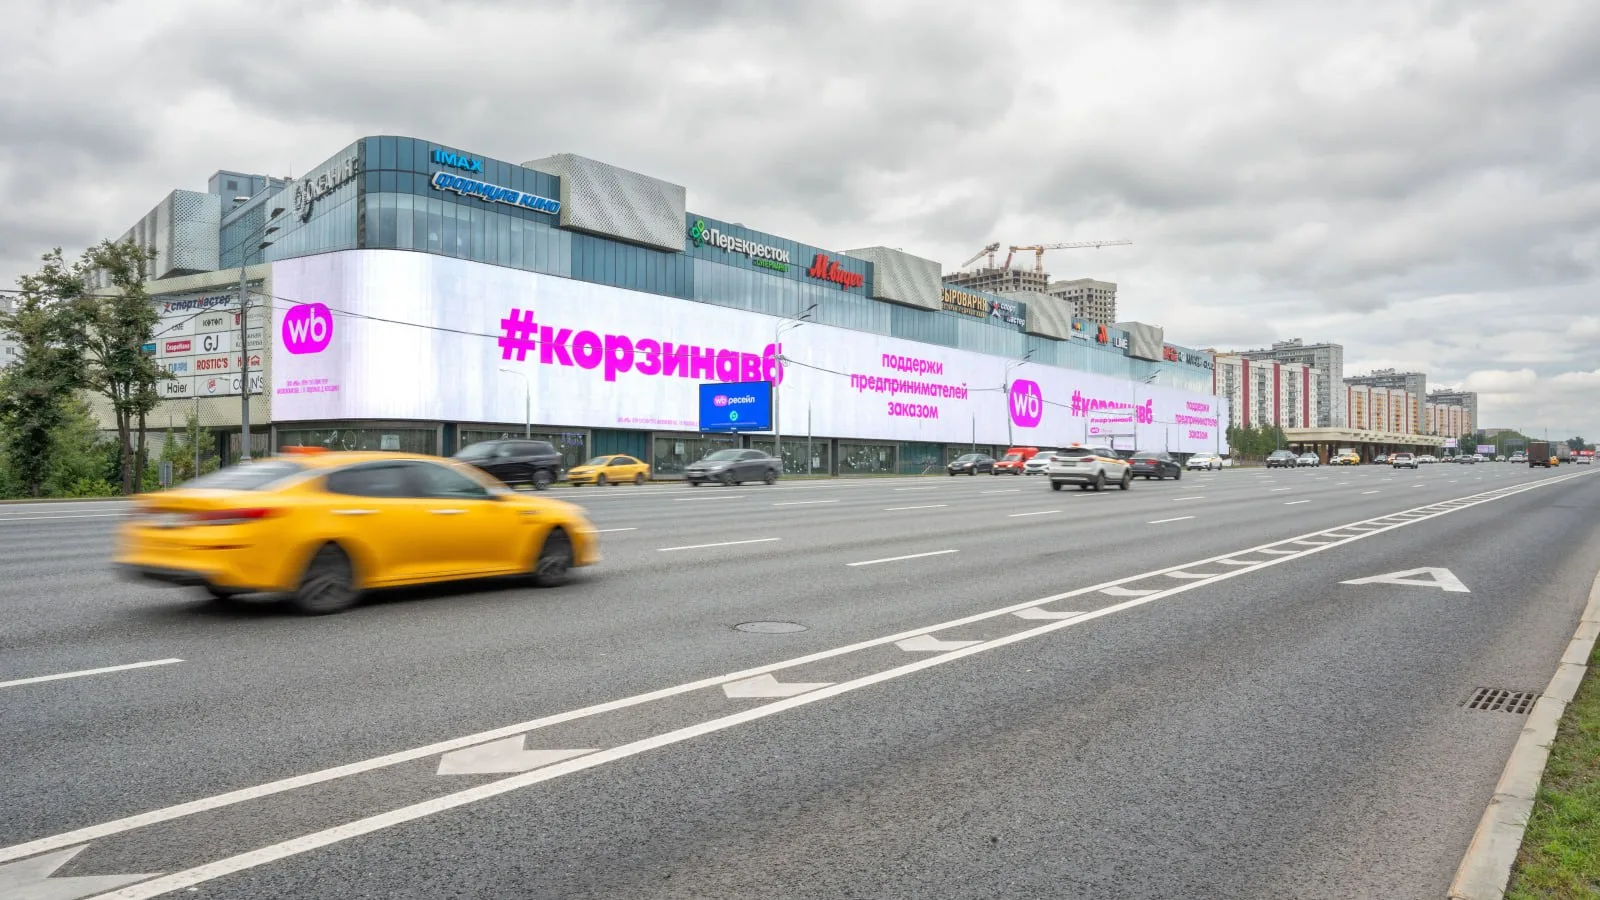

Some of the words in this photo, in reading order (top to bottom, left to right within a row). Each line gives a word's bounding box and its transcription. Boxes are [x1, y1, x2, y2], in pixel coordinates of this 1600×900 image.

[433, 148, 483, 173] IMAX
[518, 191, 561, 214] кино
[203, 335, 219, 353] GJ
[497, 308, 784, 388] #корзинавб
[196, 357, 228, 371] ROSTIC'S
[882, 353, 943, 376] поддержи
[167, 382, 188, 394] Haier
[850, 373, 968, 401] предпринимателей
[887, 401, 939, 420] заказом
